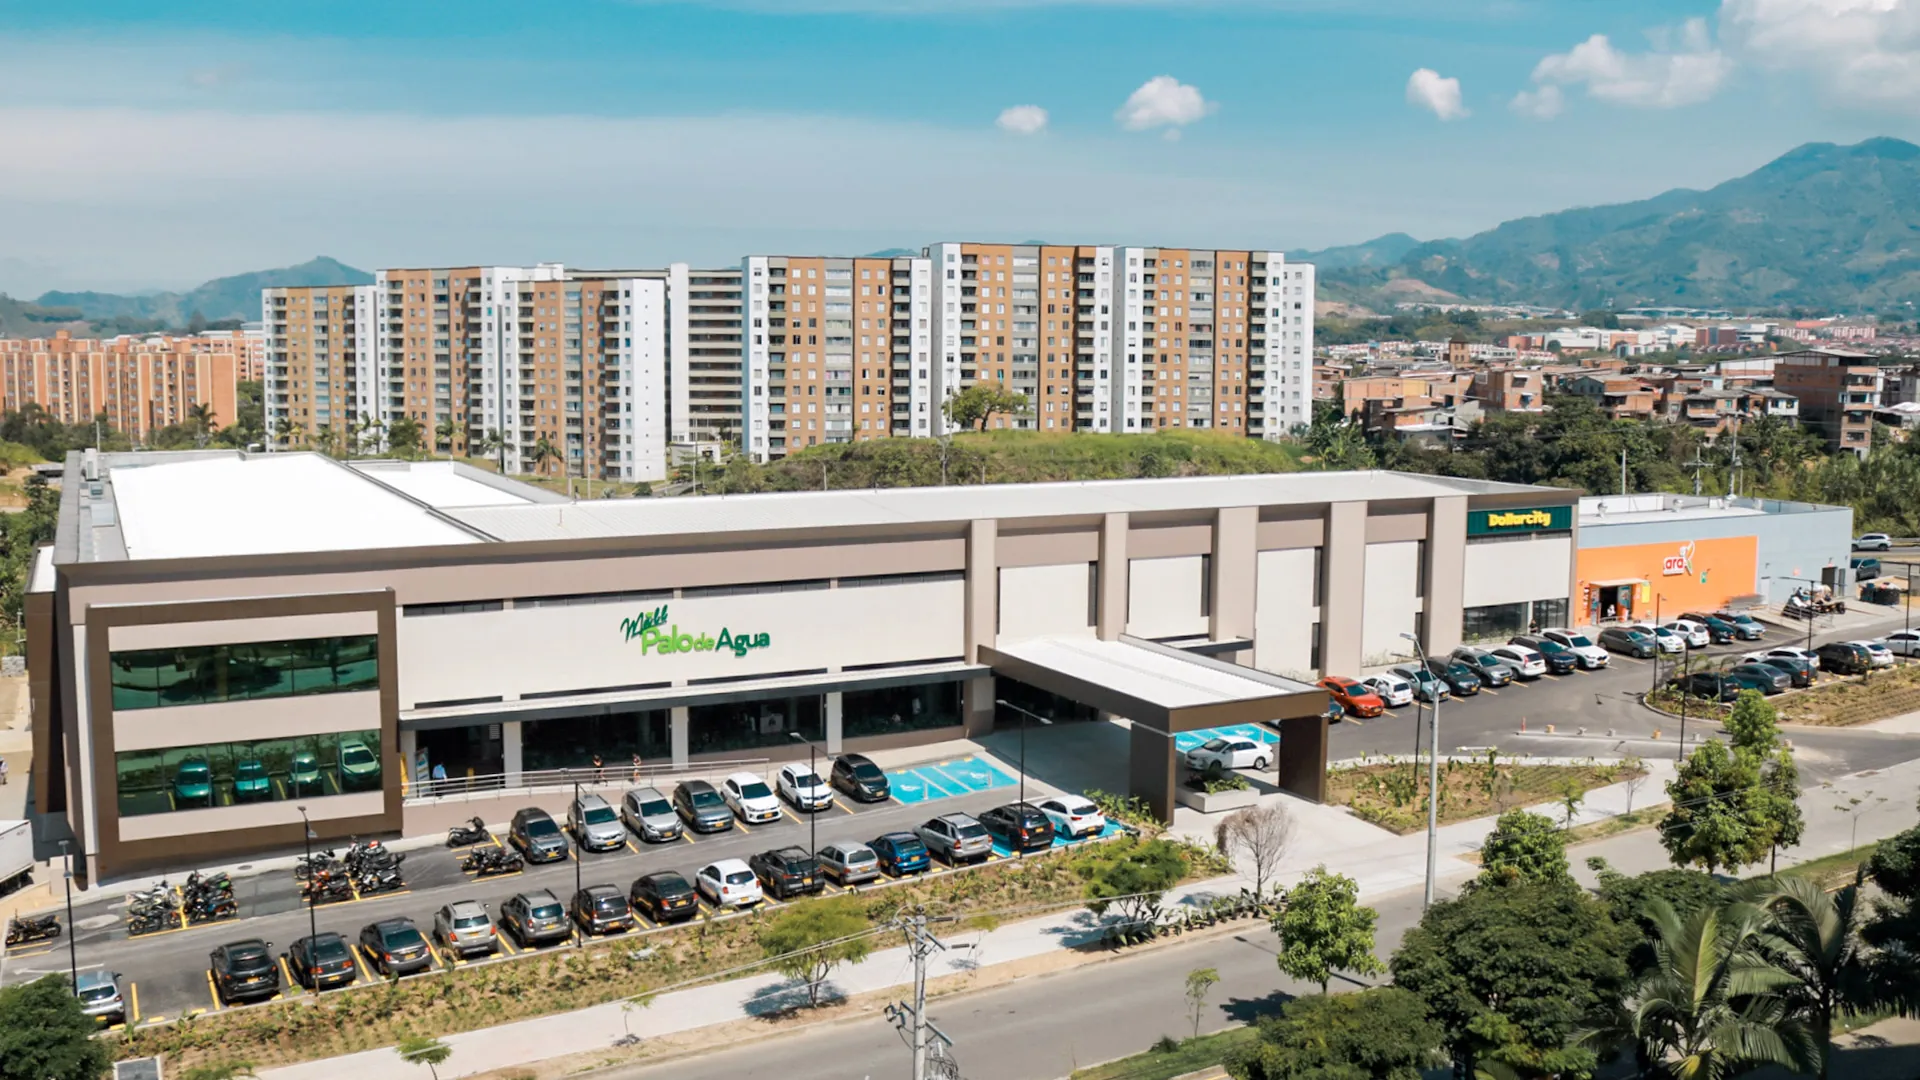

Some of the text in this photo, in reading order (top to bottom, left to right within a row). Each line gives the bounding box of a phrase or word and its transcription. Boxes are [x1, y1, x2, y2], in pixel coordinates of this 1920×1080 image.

[1488, 510, 1551, 527] Dollarcity
[1665, 557, 1685, 569] ara
[620, 604, 668, 642] Mall
[641, 624, 770, 657] Palo de Agua
